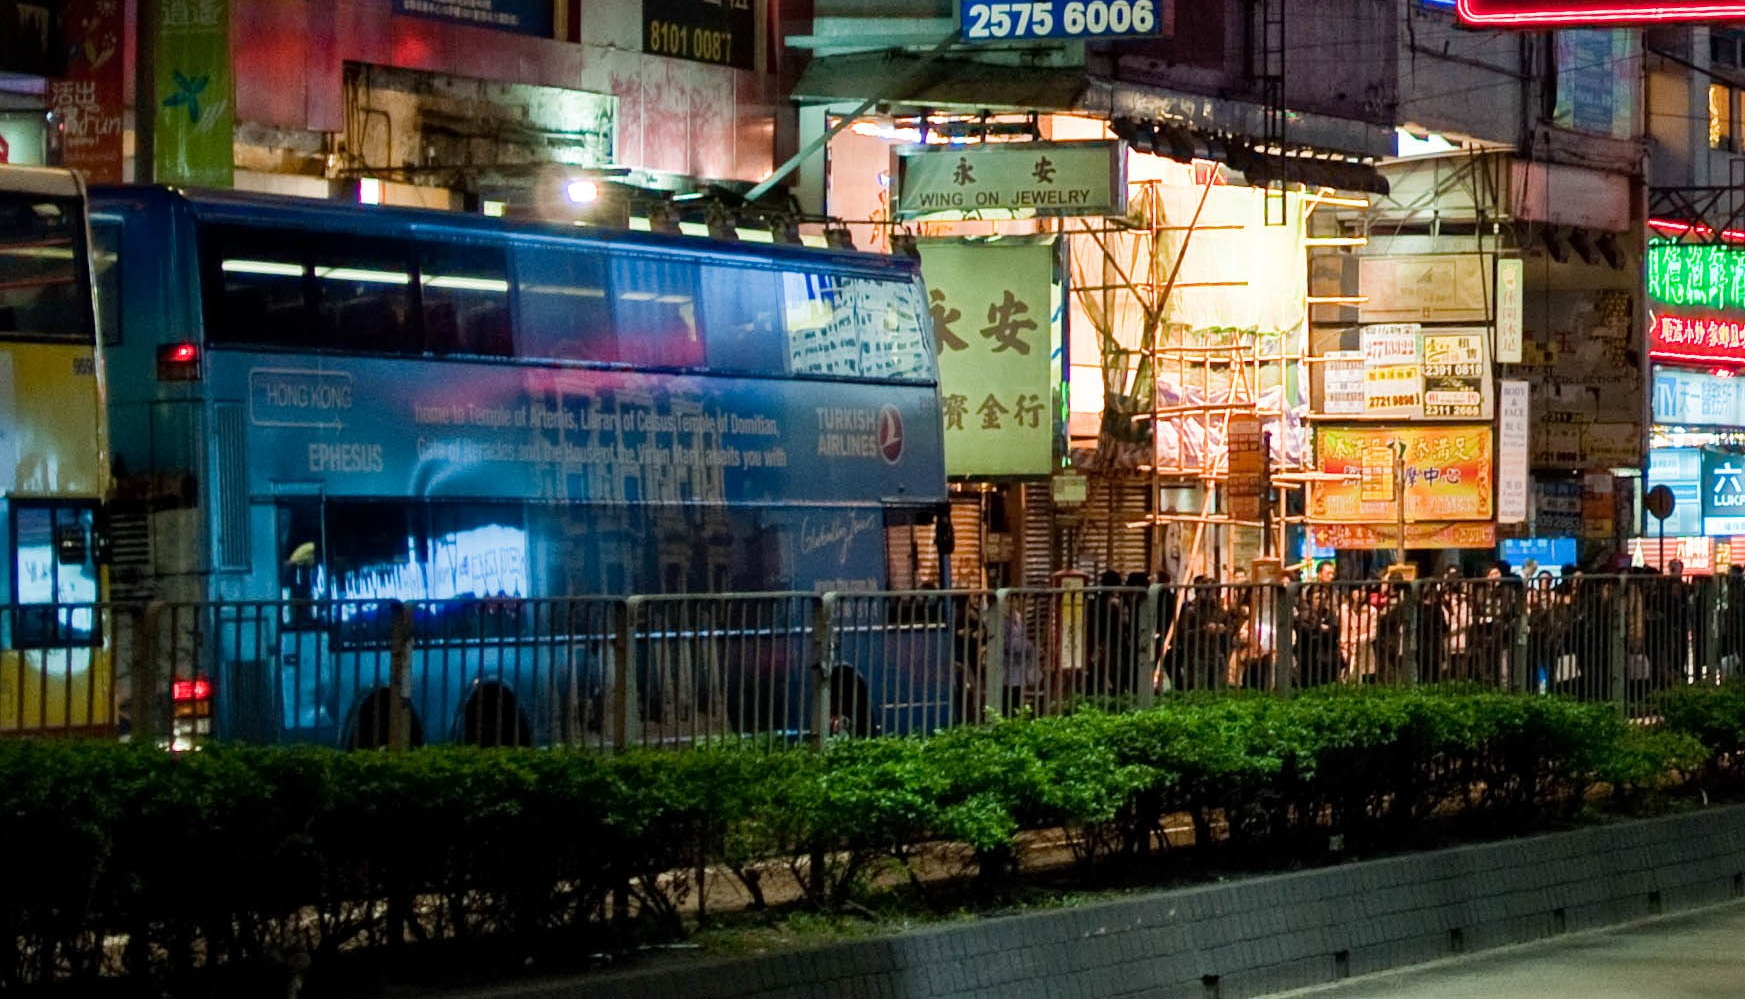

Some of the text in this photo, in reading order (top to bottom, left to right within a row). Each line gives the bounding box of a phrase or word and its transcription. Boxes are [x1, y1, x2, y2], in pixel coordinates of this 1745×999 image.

[968, 2, 1056, 38] 2575
[650, 20, 687, 55] 8101
[953, 156, 1056, 185] 永安
[920, 189, 1091, 207] WING ON JEWELRY
[267, 385, 351, 410] HONG KONG
[816, 407, 877, 431] TURKISH
[309, 443, 383, 473] EPHESUS
[817, 434, 878, 458] AIRLINES
